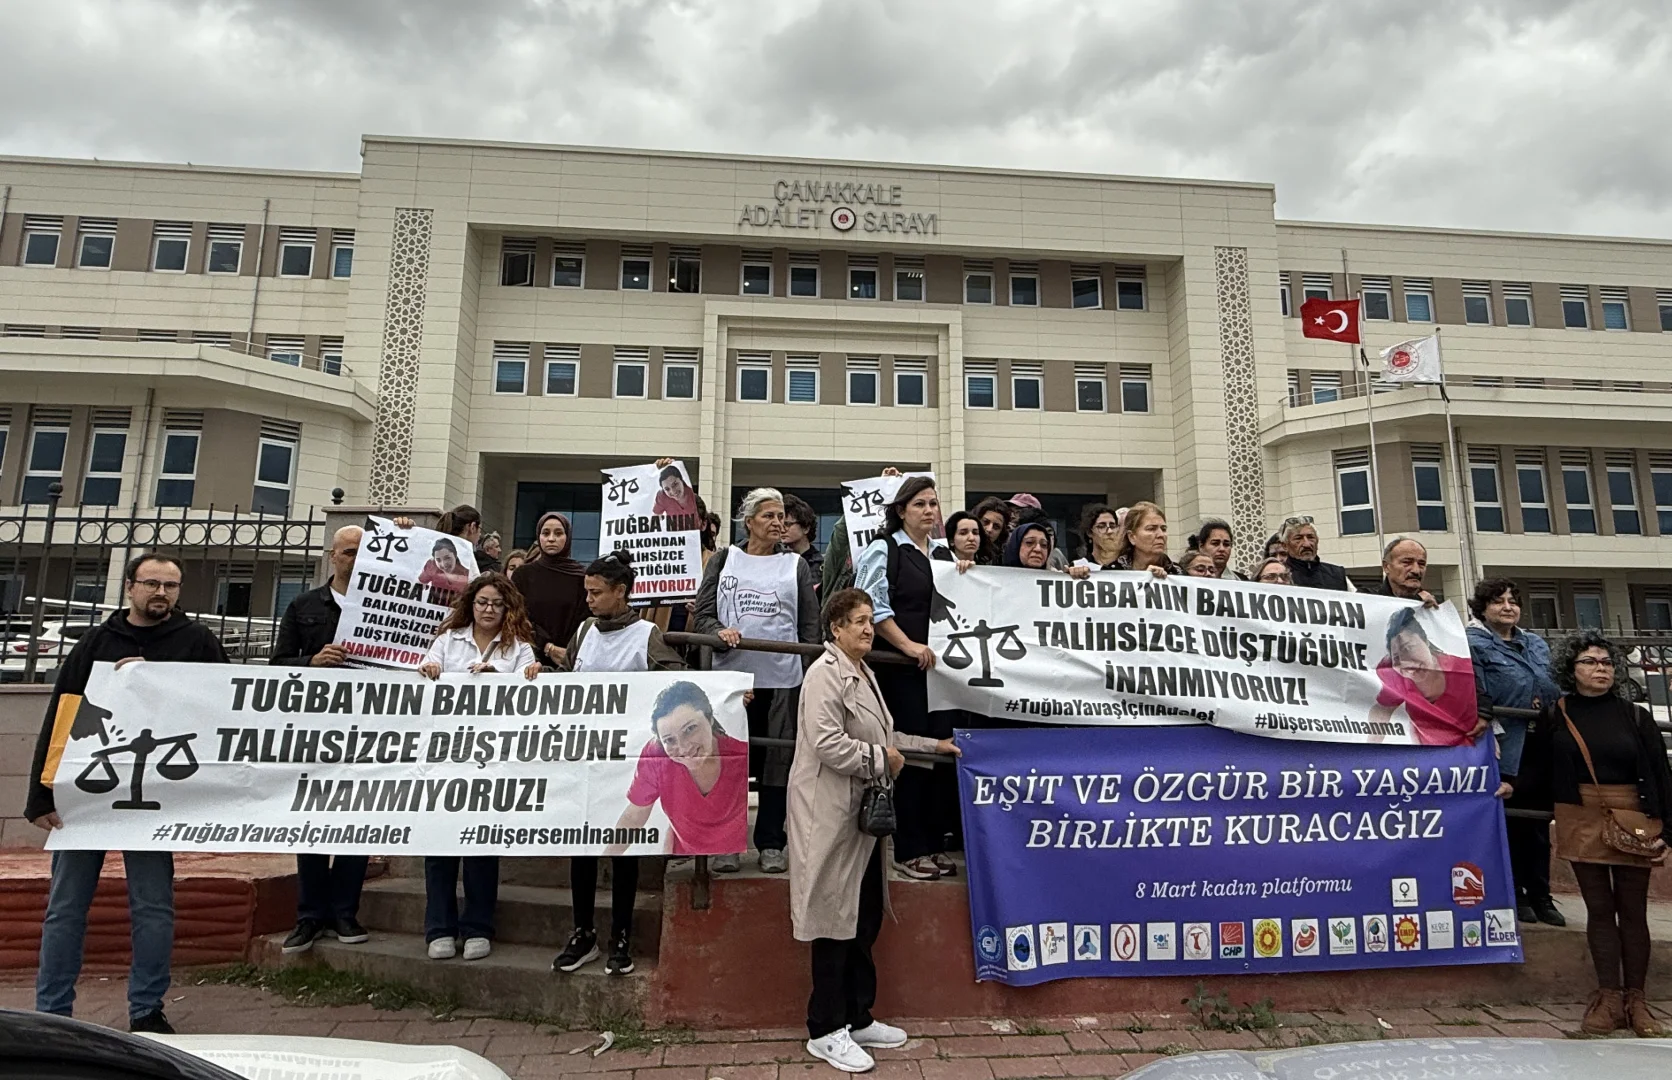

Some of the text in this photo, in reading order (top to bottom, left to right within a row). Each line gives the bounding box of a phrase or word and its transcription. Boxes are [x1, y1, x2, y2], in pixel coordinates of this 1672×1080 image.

[774, 179, 903, 206] ÇANAKKALE
[738, 204, 938, 235] ADALET SARAYI
[605, 514, 695, 536] TUĞBA'NIN
[614, 536, 686, 549] BALKONDAN
[631, 550, 684, 562] LİHSİZCE
[632, 564, 687, 577] ŞTÜĞÜNE
[630, 578, 696, 594] MIYORUZ!
[362, 597, 445, 621] BALKONDAN
[1196, 587, 1365, 629] BALKONDAN
[362, 612, 438, 635] TALİHSİZCE
[1033, 617, 1367, 671] TALİHSİZCE DÜŞTÜĞÜNE
[230, 673, 628, 716] TUĞBA'NIN BALKONDAN
[1105, 660, 1309, 705] İNANMIYORUZ!
[216, 723, 627, 769] TALİHSİZCE DÜŞTÜĞÜNE
[290, 773, 547, 812] İNANMIYORUZ!
[973, 763, 1489, 811] EŞİT VE ÖZGÜR BİR YAŞAMI
[1026, 803, 1444, 848] BİRLİKTE KURACAĞIZ
[1135, 876, 1352, 898] 8 Mart kadın platformu
[1223, 947, 1243, 956] CHP
